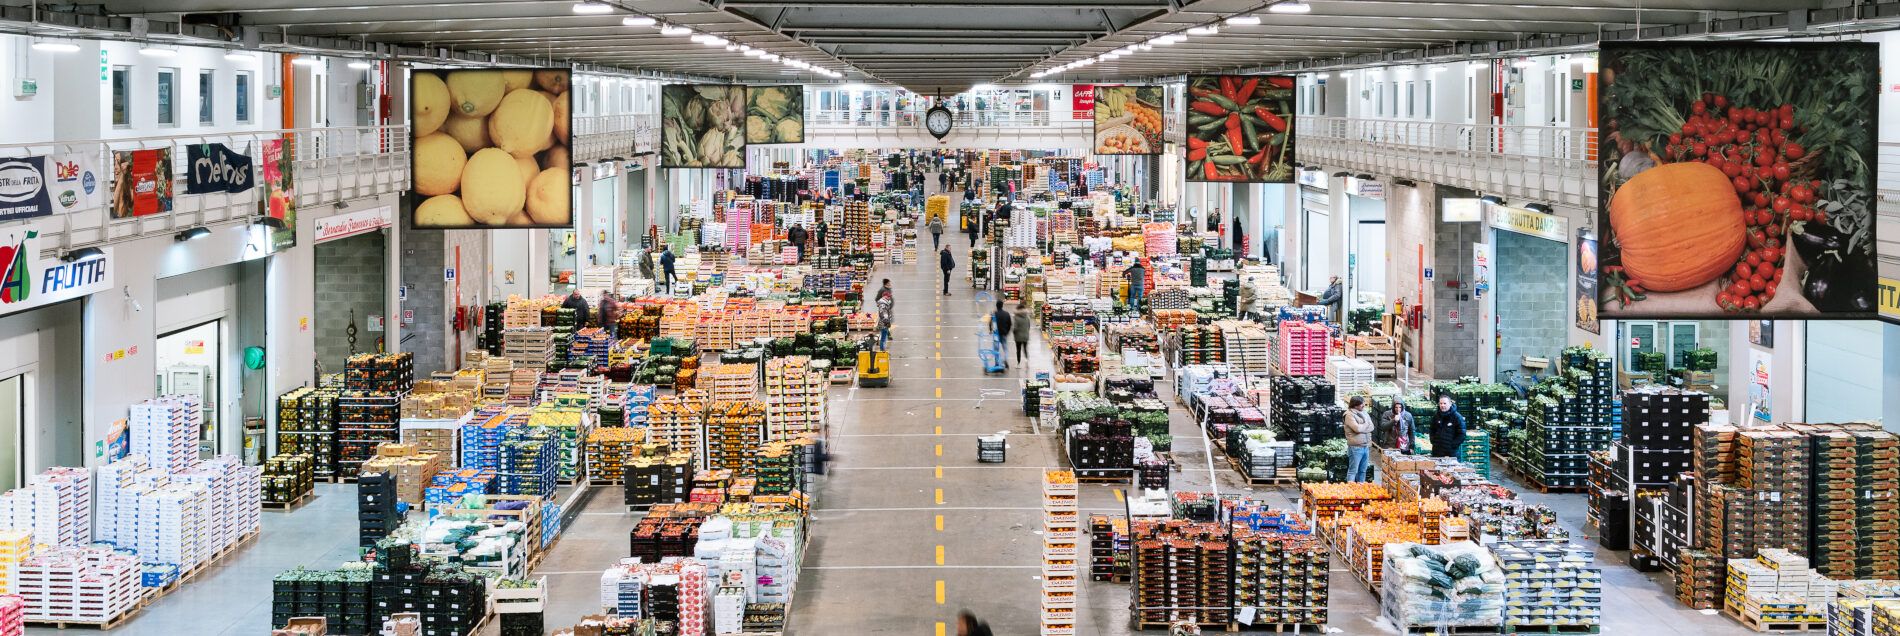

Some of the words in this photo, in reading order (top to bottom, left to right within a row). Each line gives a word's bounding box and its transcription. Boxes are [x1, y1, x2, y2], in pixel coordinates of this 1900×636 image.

[1074, 89, 1093, 97] CAFFÈ
[56, 160, 79, 178] Dole
[1497, 208, 1534, 230] EUROFRUTTA
[42, 257, 106, 294] FRUTTA
